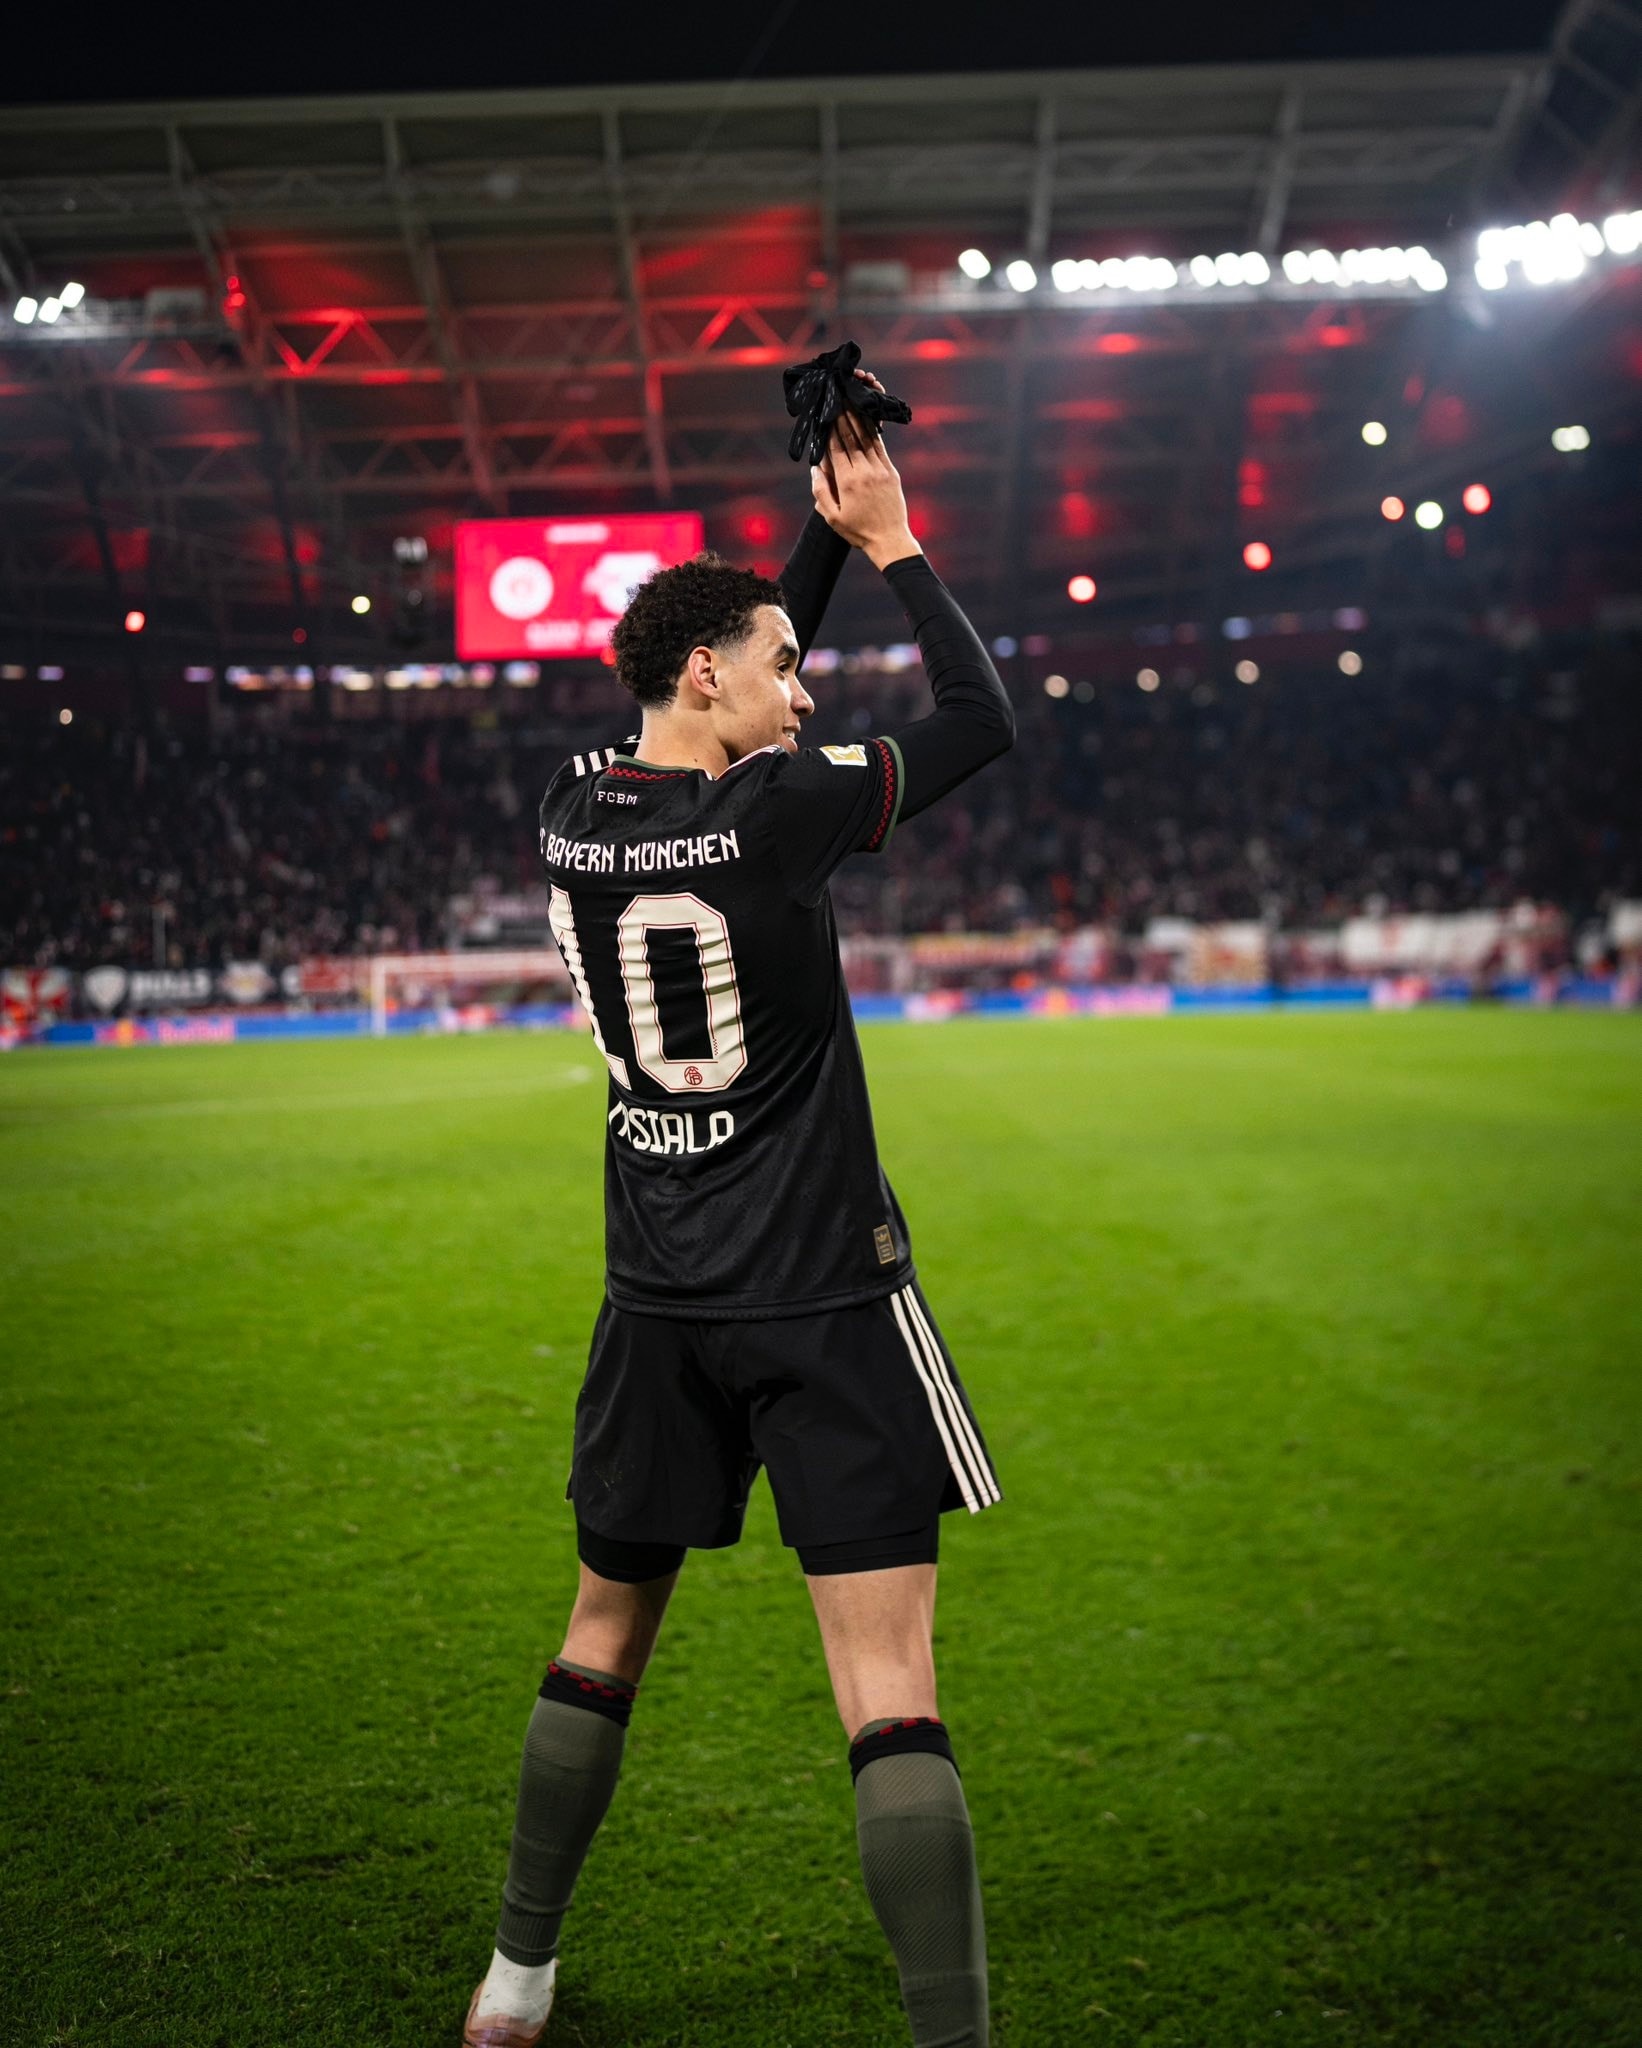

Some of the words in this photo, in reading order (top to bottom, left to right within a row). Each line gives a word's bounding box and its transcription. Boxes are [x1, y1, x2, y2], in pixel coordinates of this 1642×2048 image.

[597, 790, 638, 805] FCBM
[546, 833, 615, 873] BAYERN
[624, 829, 741, 872] MÜNCHEN
[548, 883, 748, 1093] 10
